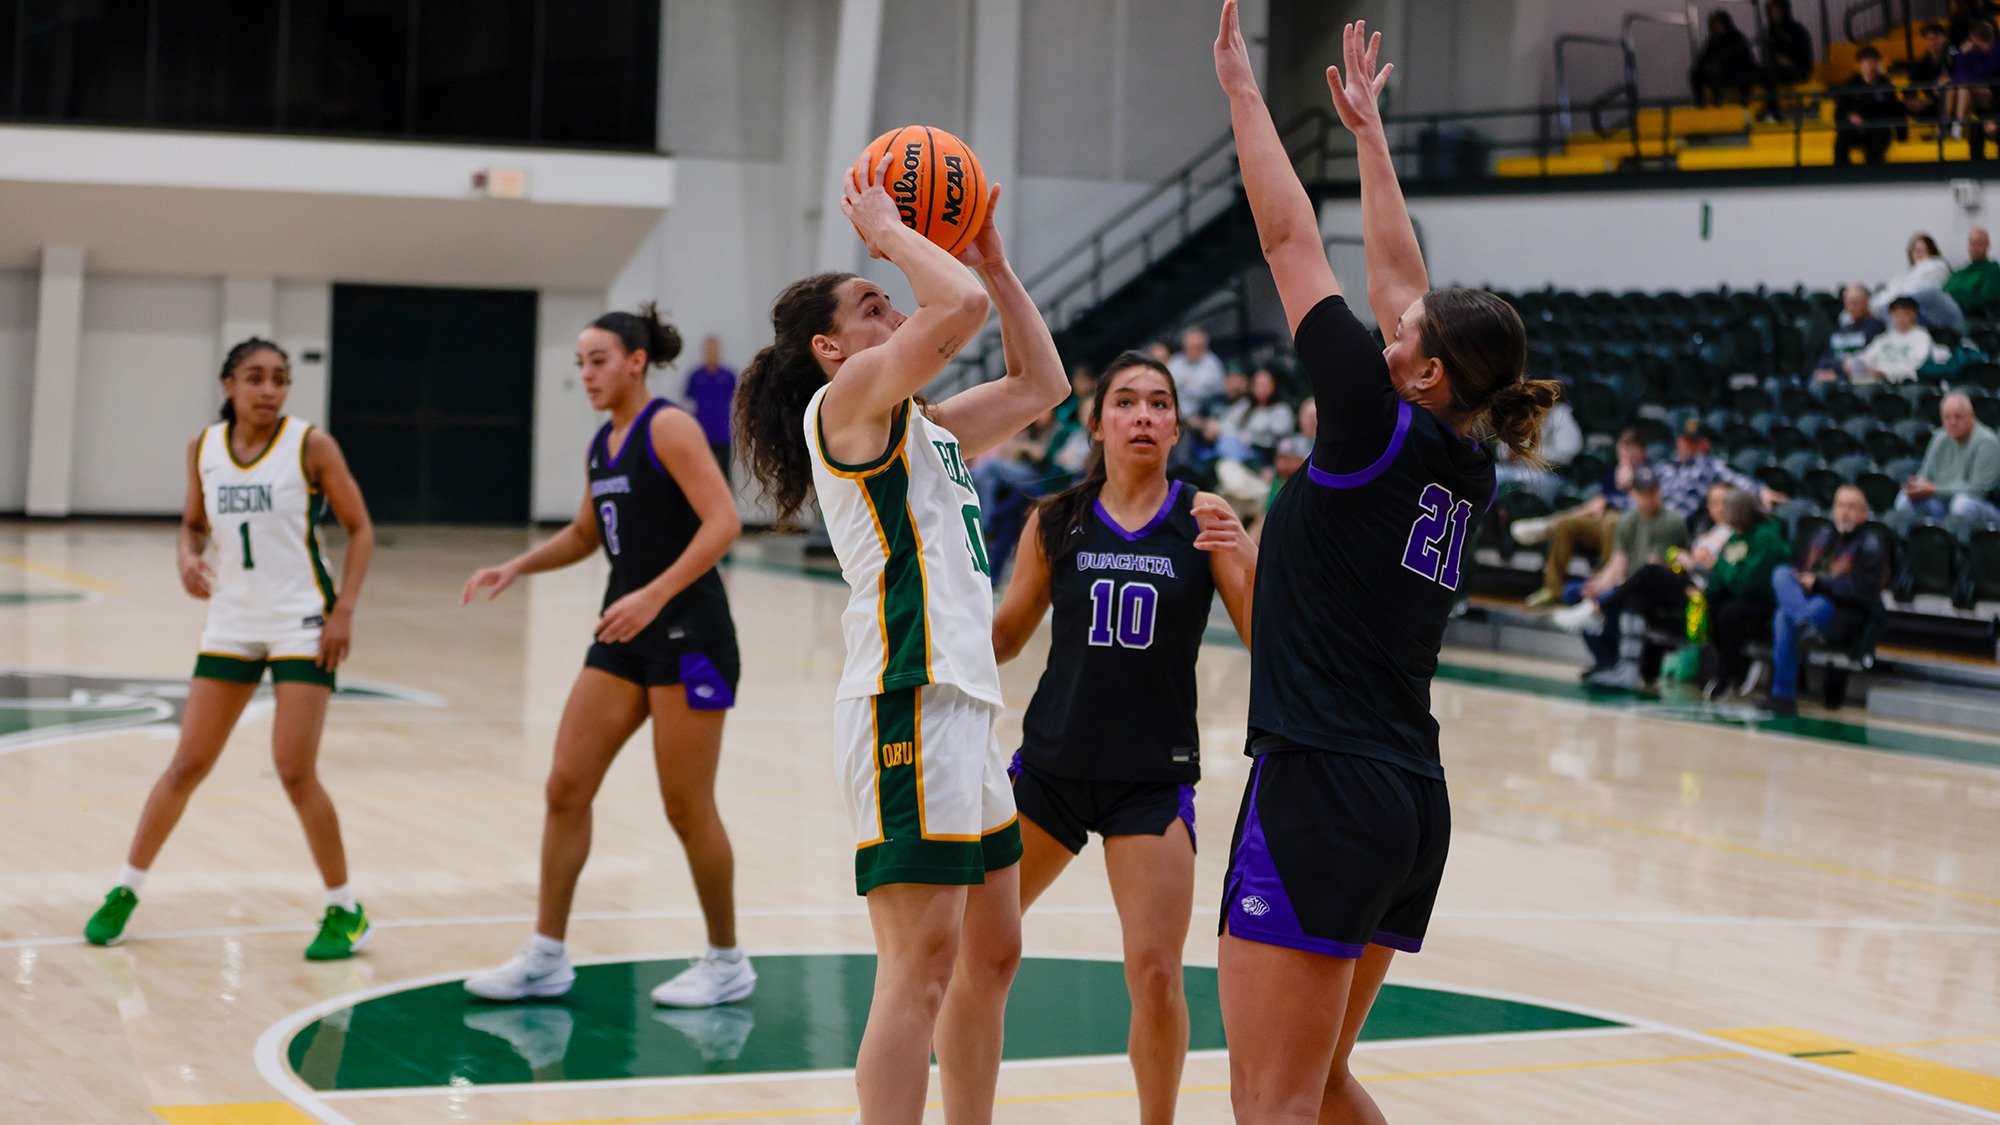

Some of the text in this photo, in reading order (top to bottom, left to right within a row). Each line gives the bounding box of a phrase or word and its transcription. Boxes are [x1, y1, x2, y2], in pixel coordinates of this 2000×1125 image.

[941, 155, 964, 227] NCAA
[218, 485, 272, 514] BISON
[239, 520, 254, 569] 1
[961, 503, 991, 577] 0
[1076, 551, 1175, 579] OUACHITA
[1401, 482, 1473, 592] 21
[1088, 578, 1158, 650] 10
[882, 741, 913, 768] OBU
